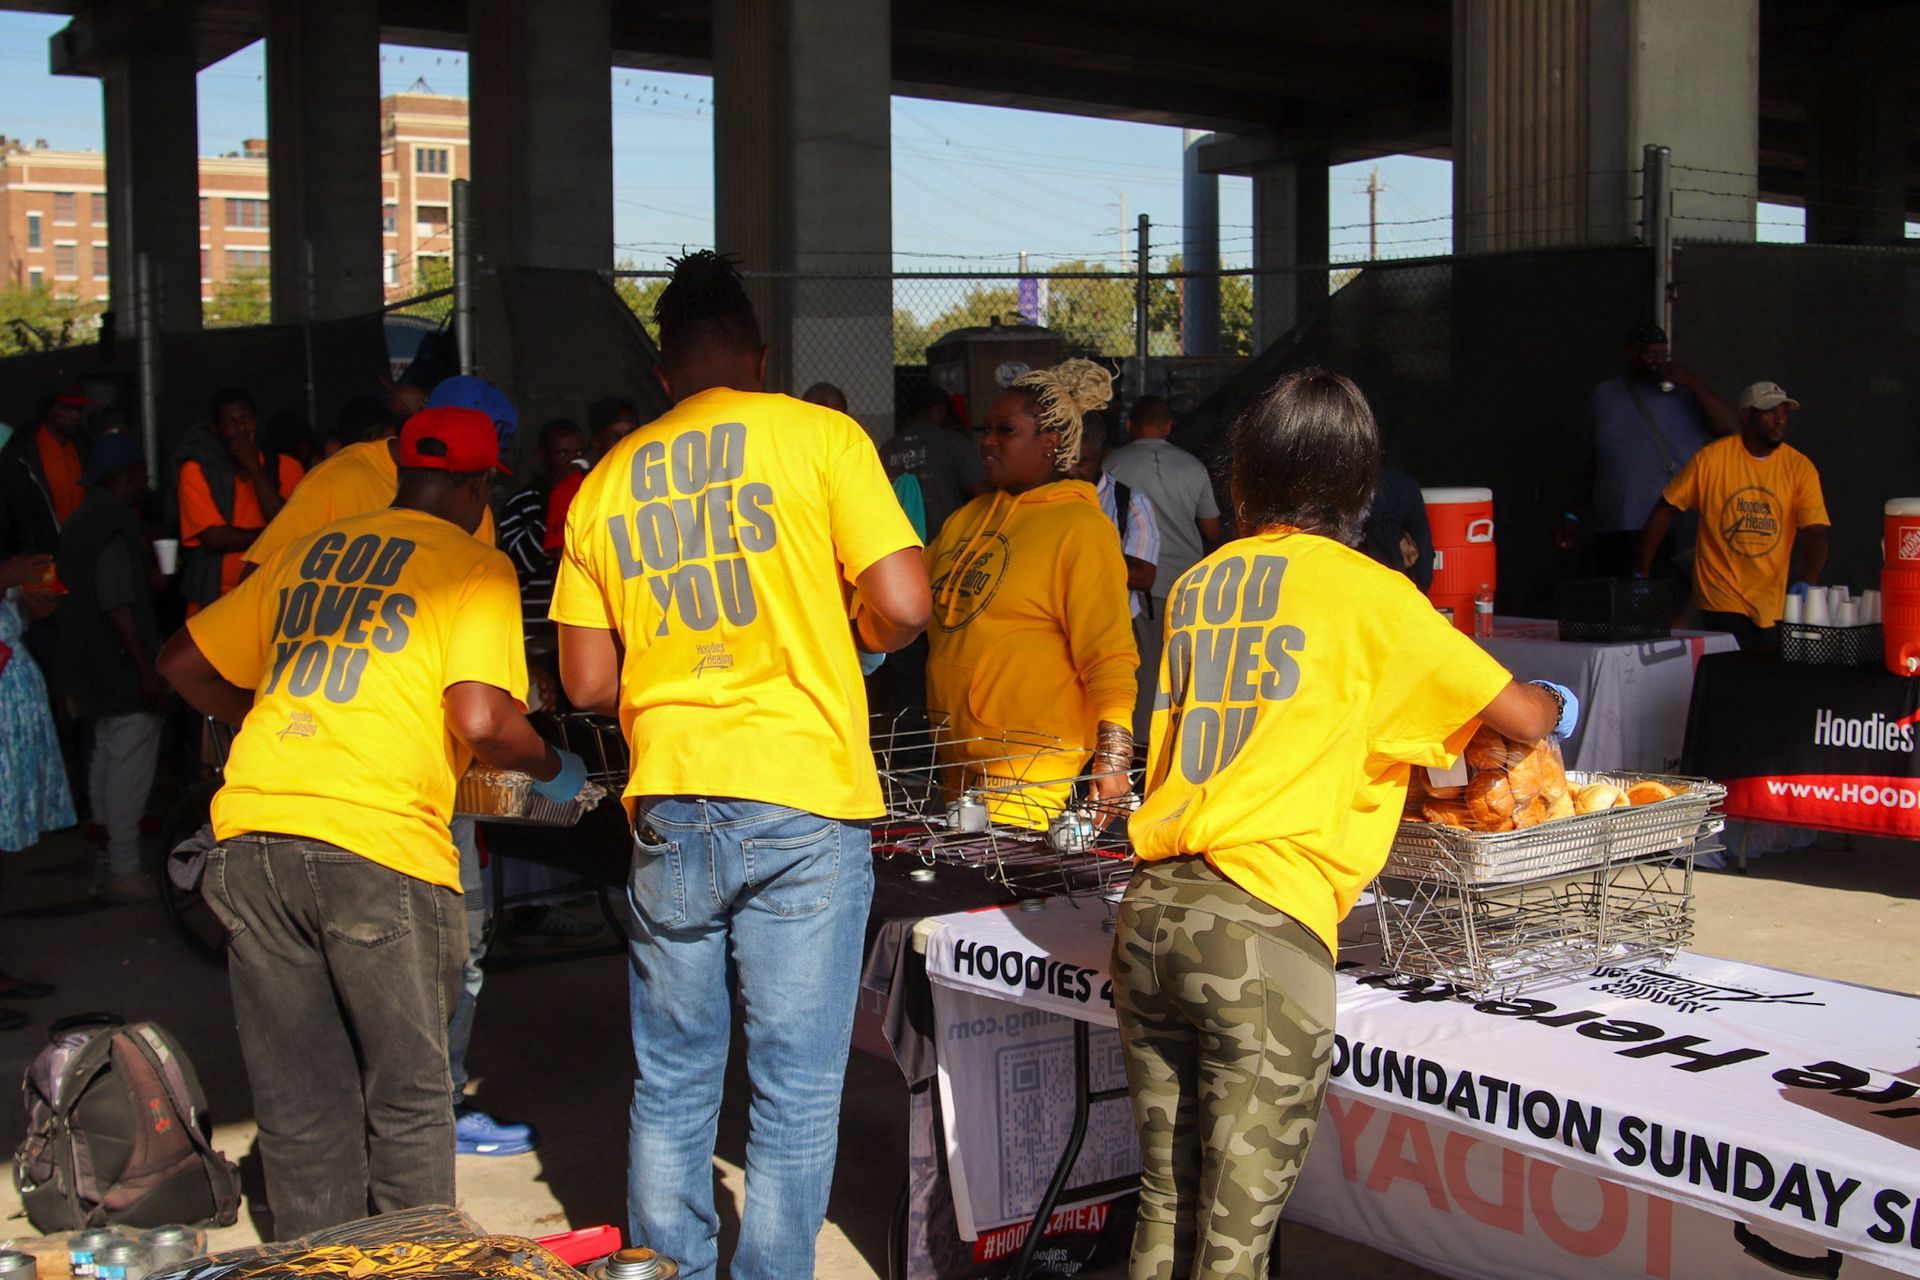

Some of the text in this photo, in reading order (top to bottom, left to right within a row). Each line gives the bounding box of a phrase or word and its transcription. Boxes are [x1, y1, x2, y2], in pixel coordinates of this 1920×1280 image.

[630, 422, 747, 503] GOD
[300, 531, 417, 587] GOD
[608, 482, 777, 580] LOVES
[648, 557, 758, 637] YOU
[1171, 554, 1288, 630] GOD
[264, 639, 370, 704] YOU
[1153, 624, 1306, 711] OVES
[1172, 706, 1259, 785] OU
[1814, 708, 1915, 753] Hoodies
[1473, 998, 1770, 1073] Here
[954, 938, 1100, 1003] HOODIES
[1331, 1034, 1602, 1155] OUNDATION
[1613, 1115, 1862, 1228] SUNDAY
